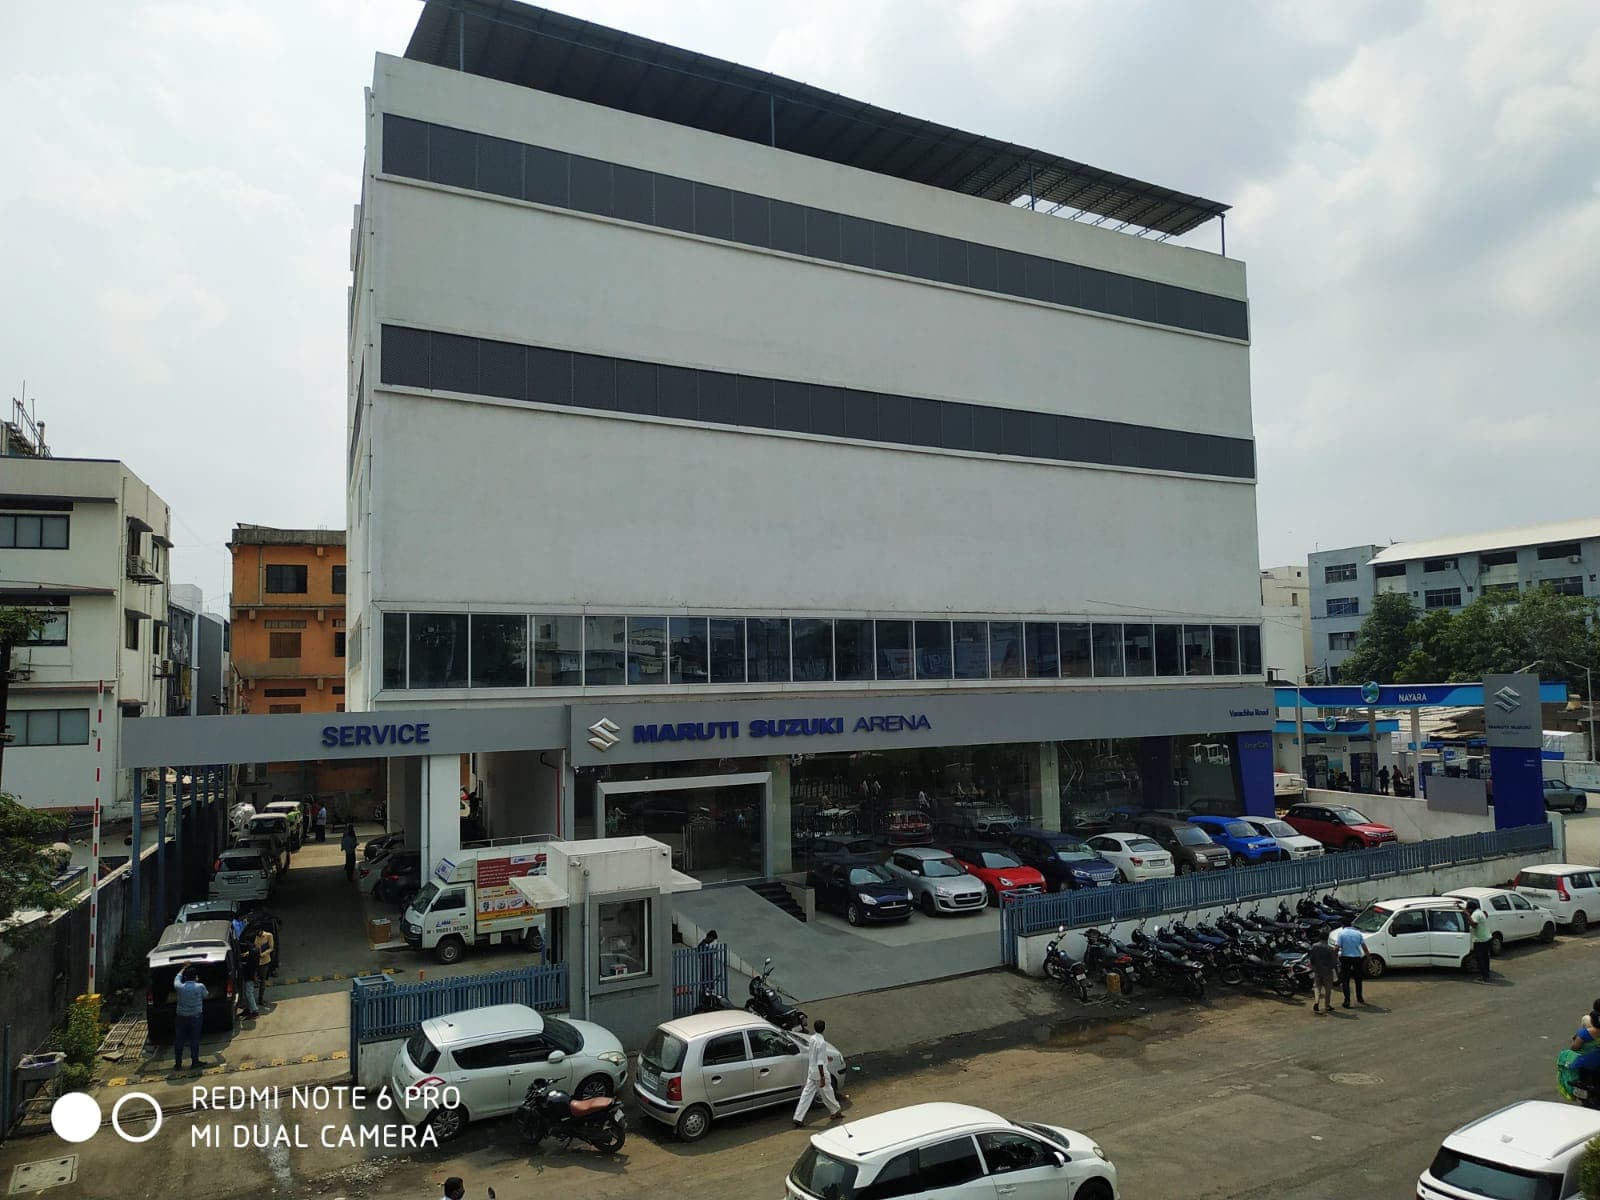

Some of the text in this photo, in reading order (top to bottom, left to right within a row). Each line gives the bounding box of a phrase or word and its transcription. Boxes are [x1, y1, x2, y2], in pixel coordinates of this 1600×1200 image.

[1398, 692, 1427, 703] NAYARA
[1254, 707, 1269, 716] Road
[322, 723, 431, 747] SERVICE
[633, 713, 932, 743] MARUTI SUZUKI ARENA
